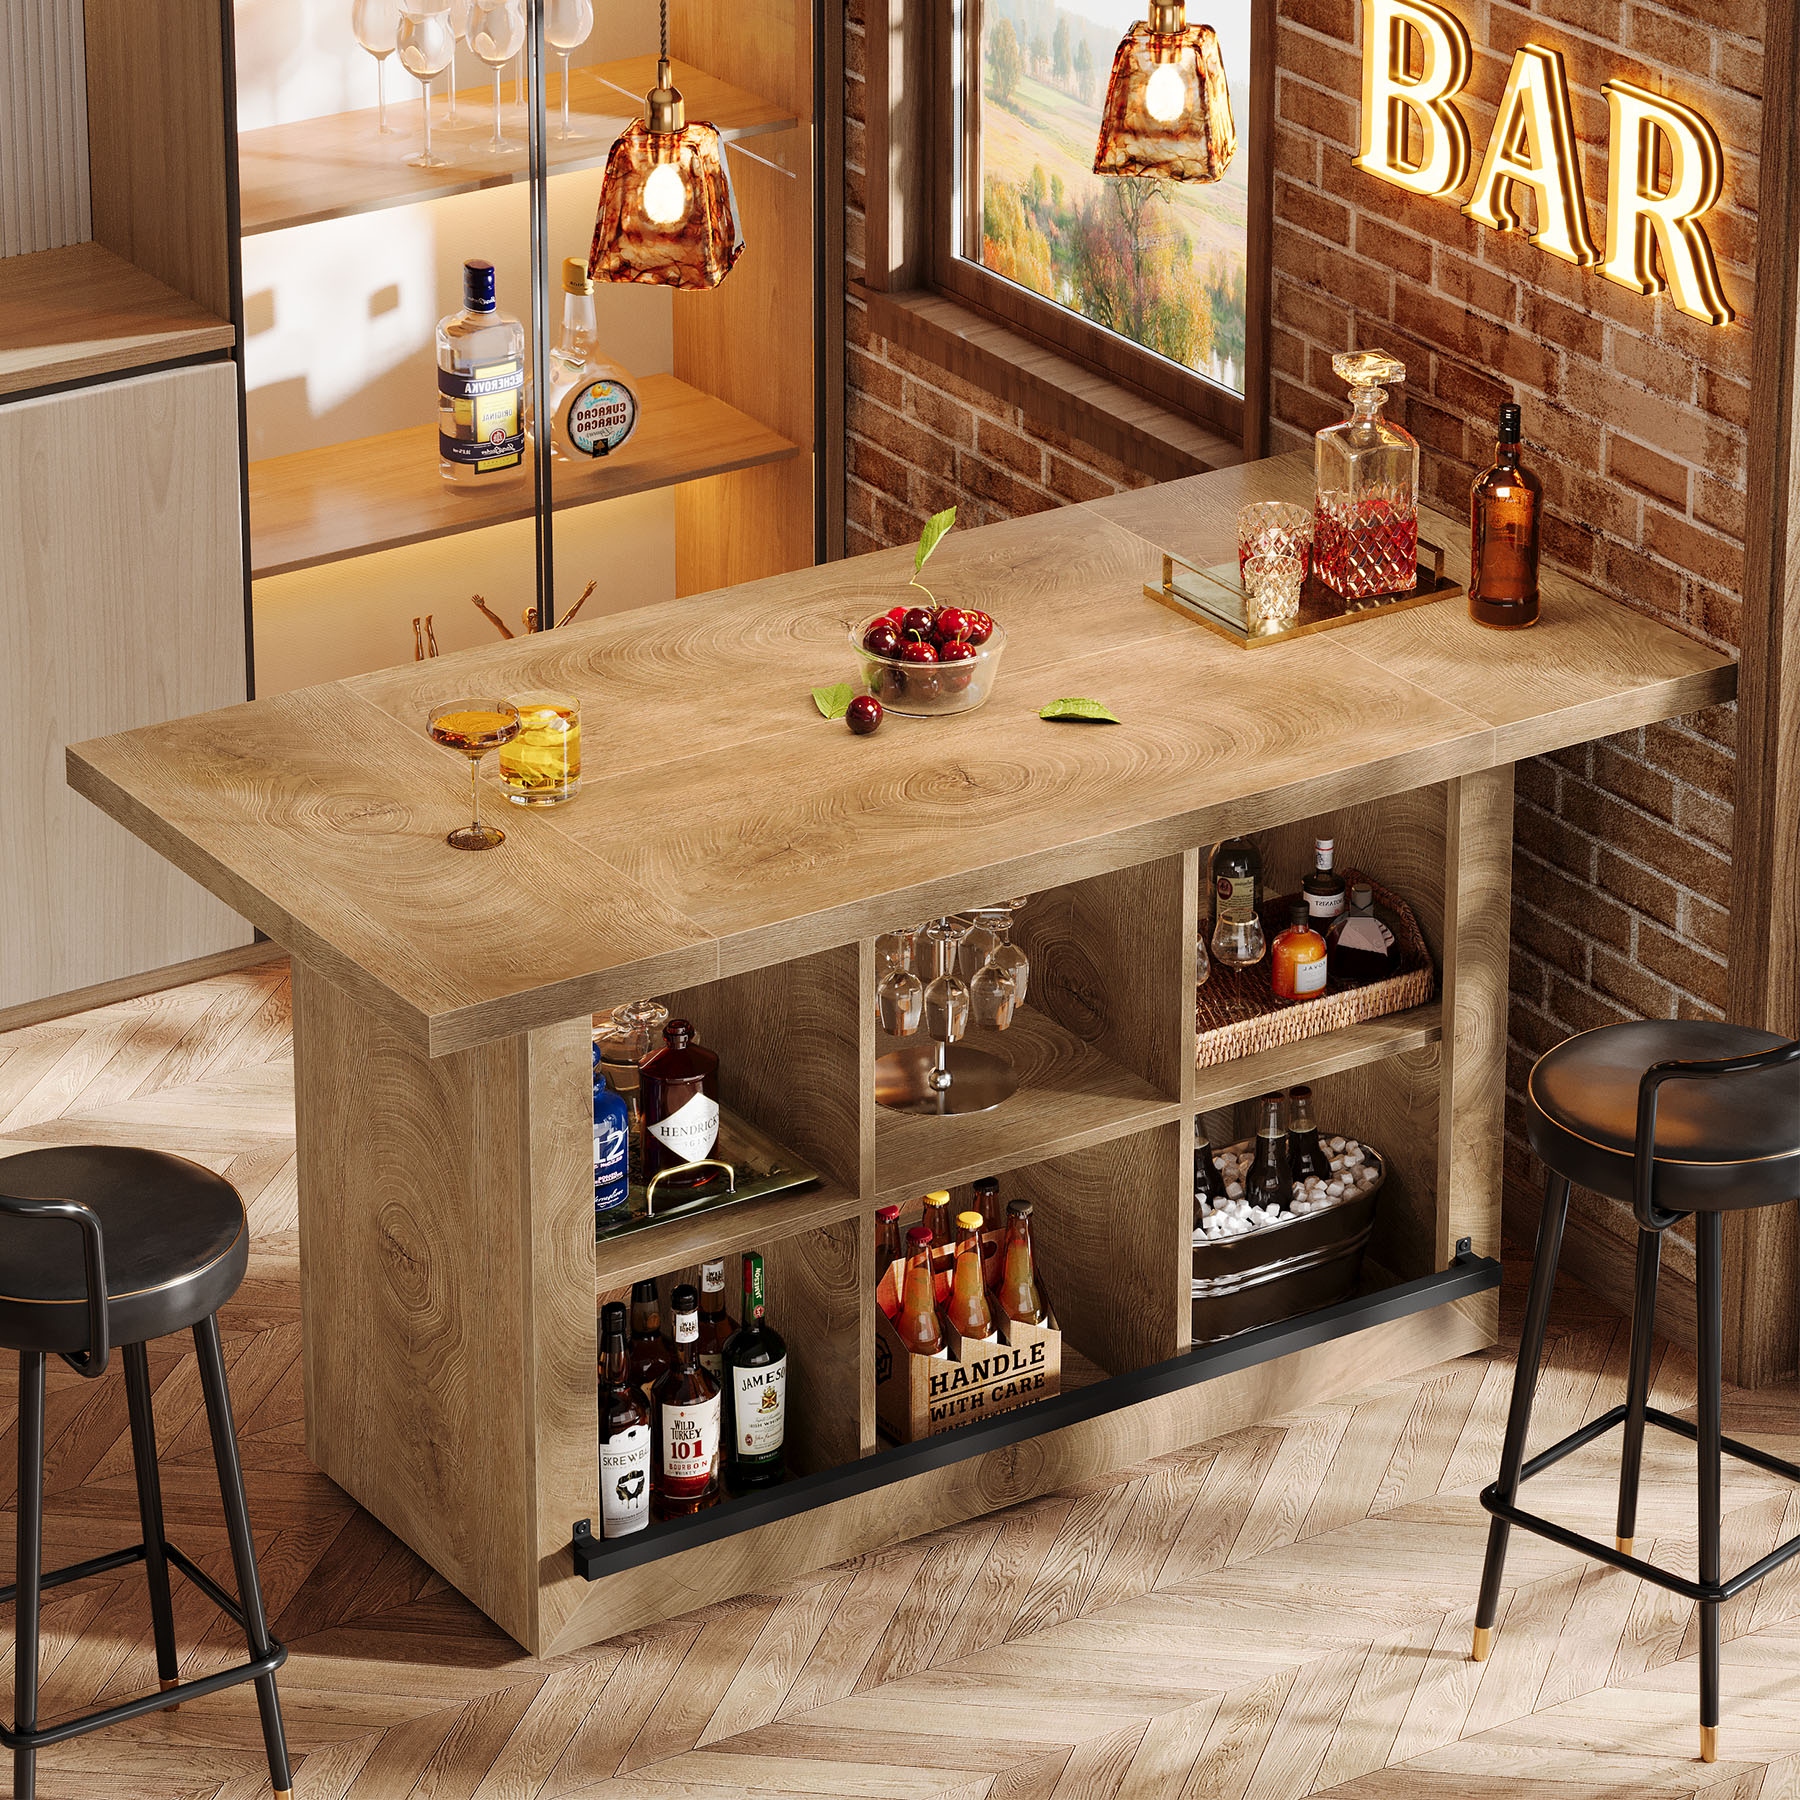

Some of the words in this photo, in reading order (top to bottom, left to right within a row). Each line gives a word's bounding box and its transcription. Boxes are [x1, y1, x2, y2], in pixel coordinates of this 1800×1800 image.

[1352, 0, 1735, 326] BAR
[660, 1112, 719, 1137] HENDRICK
[753, 1267, 762, 1299] JAMESON
[930, 1341, 1045, 1396] HANDLE
[930, 1390, 985, 1422] WITH
[991, 1372, 1045, 1402] CARE
[670, 1428, 702, 1441] TURKEY
[673, 1420, 695, 1431] WILD
[670, 1439, 704, 1460] 101
[669, 1460, 708, 1471] BOURBON
